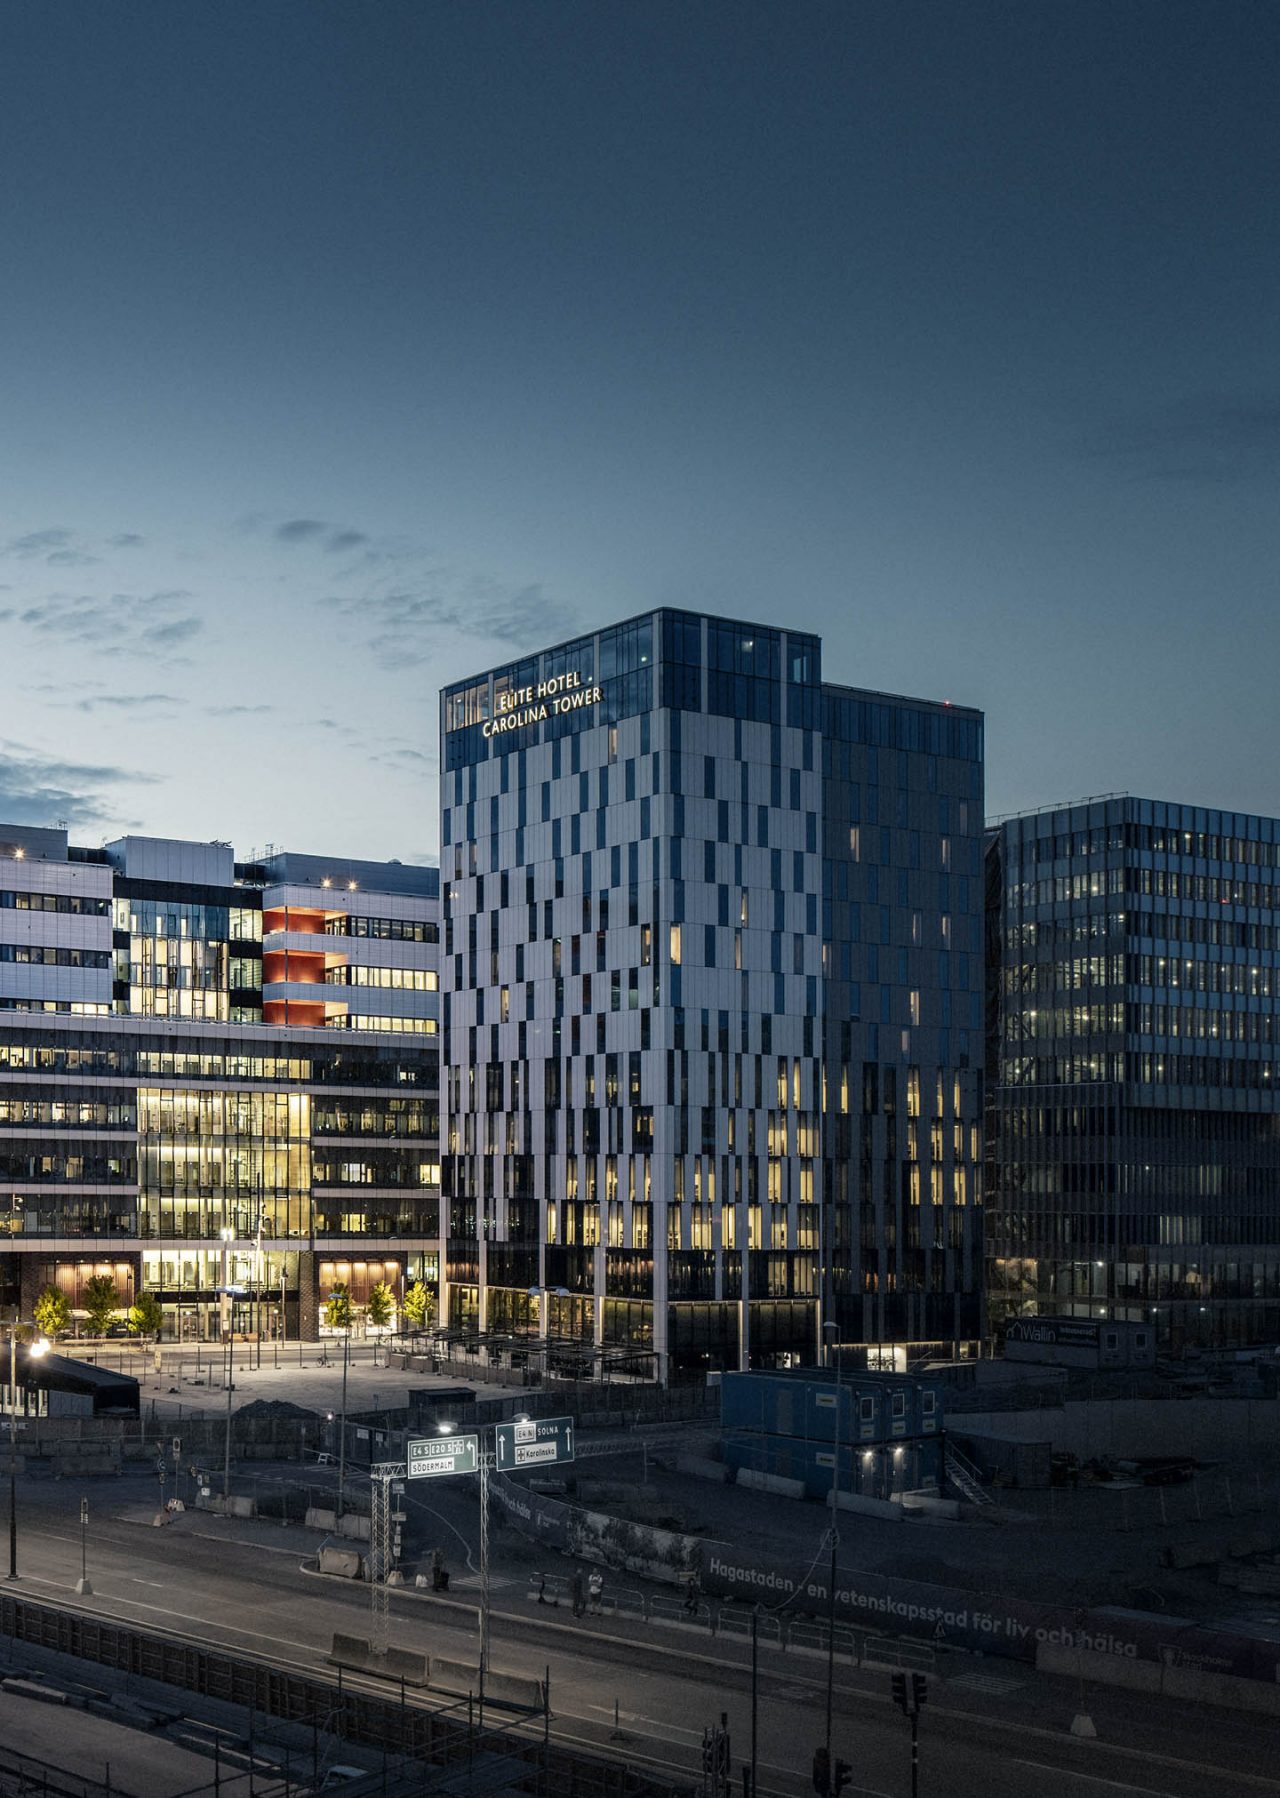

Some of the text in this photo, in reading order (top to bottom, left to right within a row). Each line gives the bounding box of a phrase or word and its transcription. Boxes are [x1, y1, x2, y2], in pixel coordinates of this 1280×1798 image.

[500, 671, 582, 711] ELITE HOTEL
[482, 686, 602, 738] CAROLINA TOWER
[1022, 1324, 1056, 1343] Wallin
[518, 1428, 533, 1438] E4 N
[537, 1425, 559, 1437] SOLNA
[412, 1445, 430, 1456] E4 S
[431, 1443, 445, 1455] E20
[526, 1447, 556, 1459] Karolinska
[412, 1460, 453, 1473] SÖDERMALM
[709, 1557, 794, 1593] Hagastaden
[807, 1583, 828, 1600] en
[972, 1612, 1001, 1635] för
[1006, 1617, 1031, 1639] liv
[1035, 1627, 1075, 1647] och
[1081, 1629, 1138, 1659] hälsa
